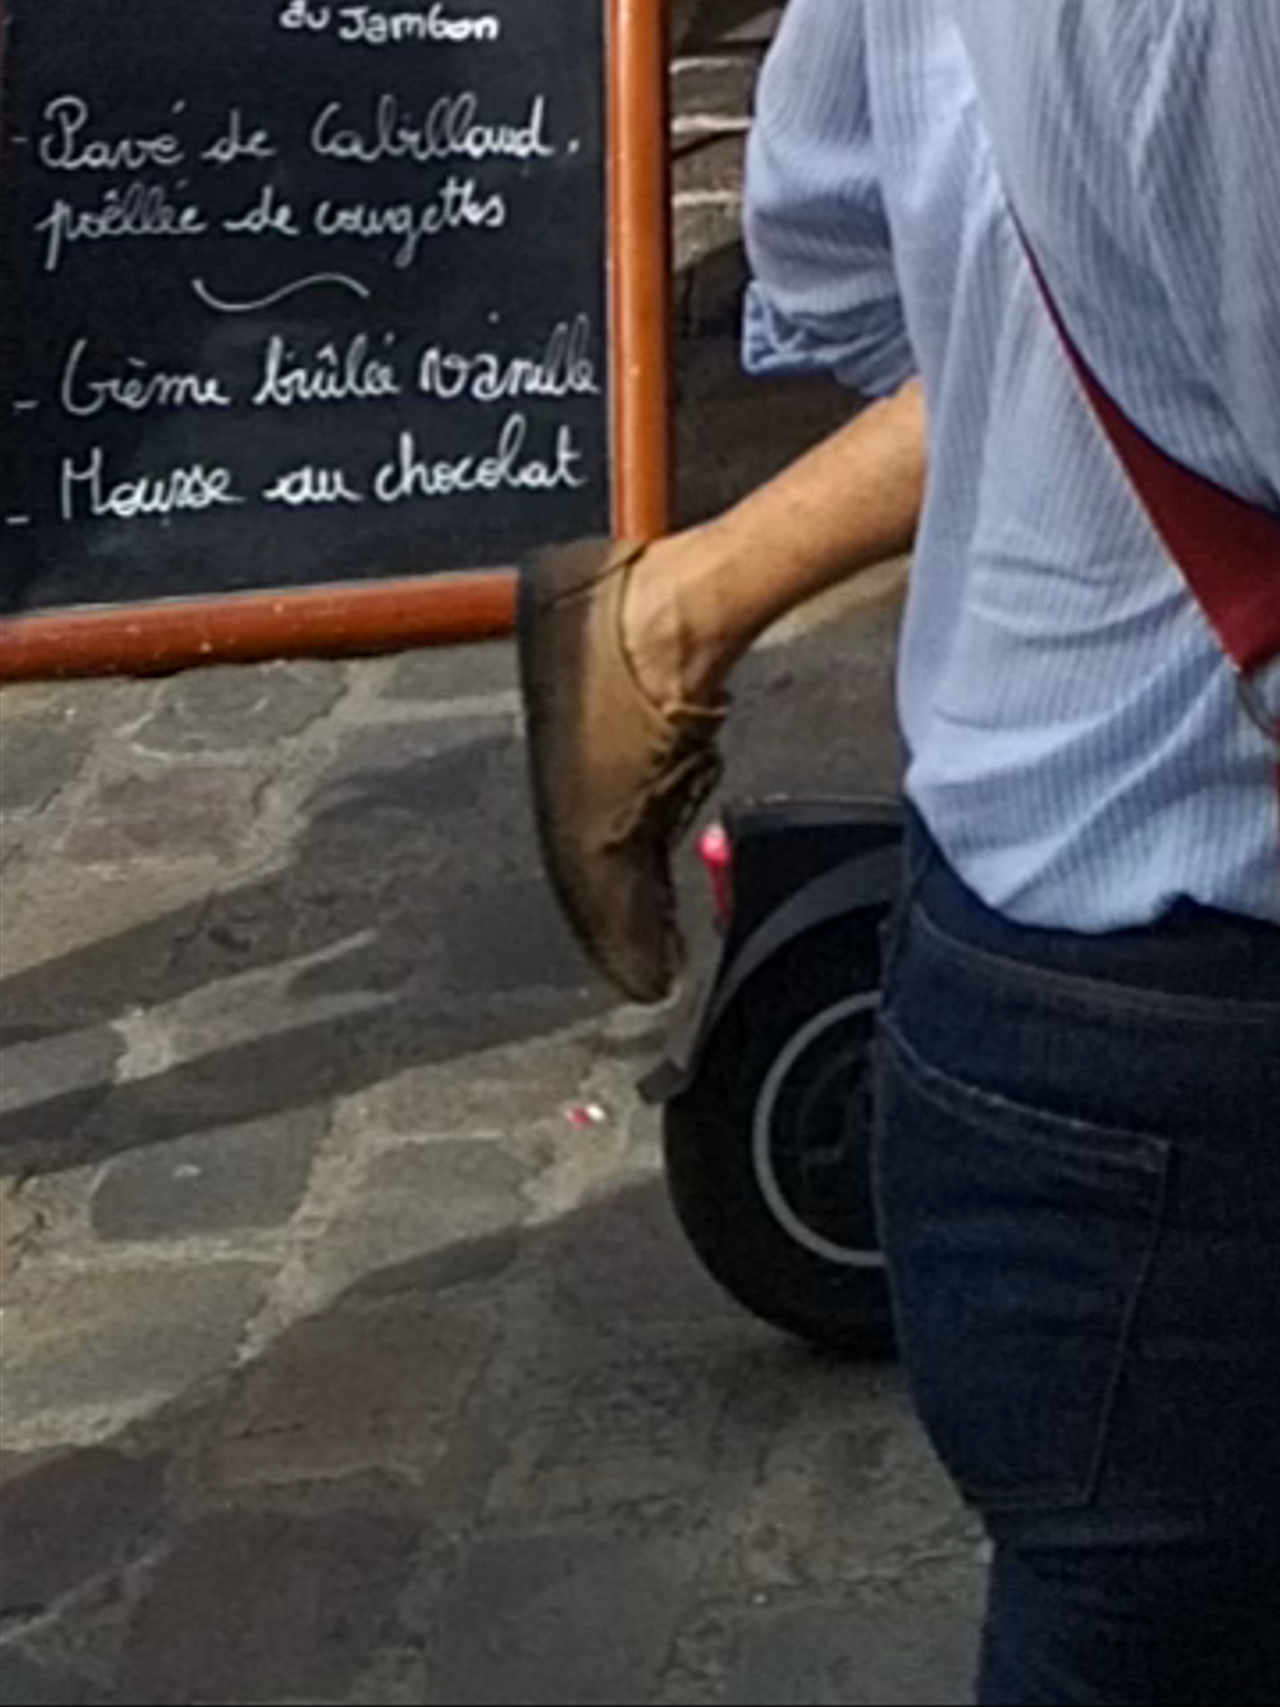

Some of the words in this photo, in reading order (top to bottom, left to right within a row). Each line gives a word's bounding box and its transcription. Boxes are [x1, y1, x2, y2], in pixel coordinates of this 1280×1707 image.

[40, 96, 185, 170] Pavé
[202, 109, 277, 162] de
[223, 185, 299, 235] de
[62, 446, 246, 519] Mousse
[262, 464, 364, 503] au
[375, 412, 583, 502] chocolat
